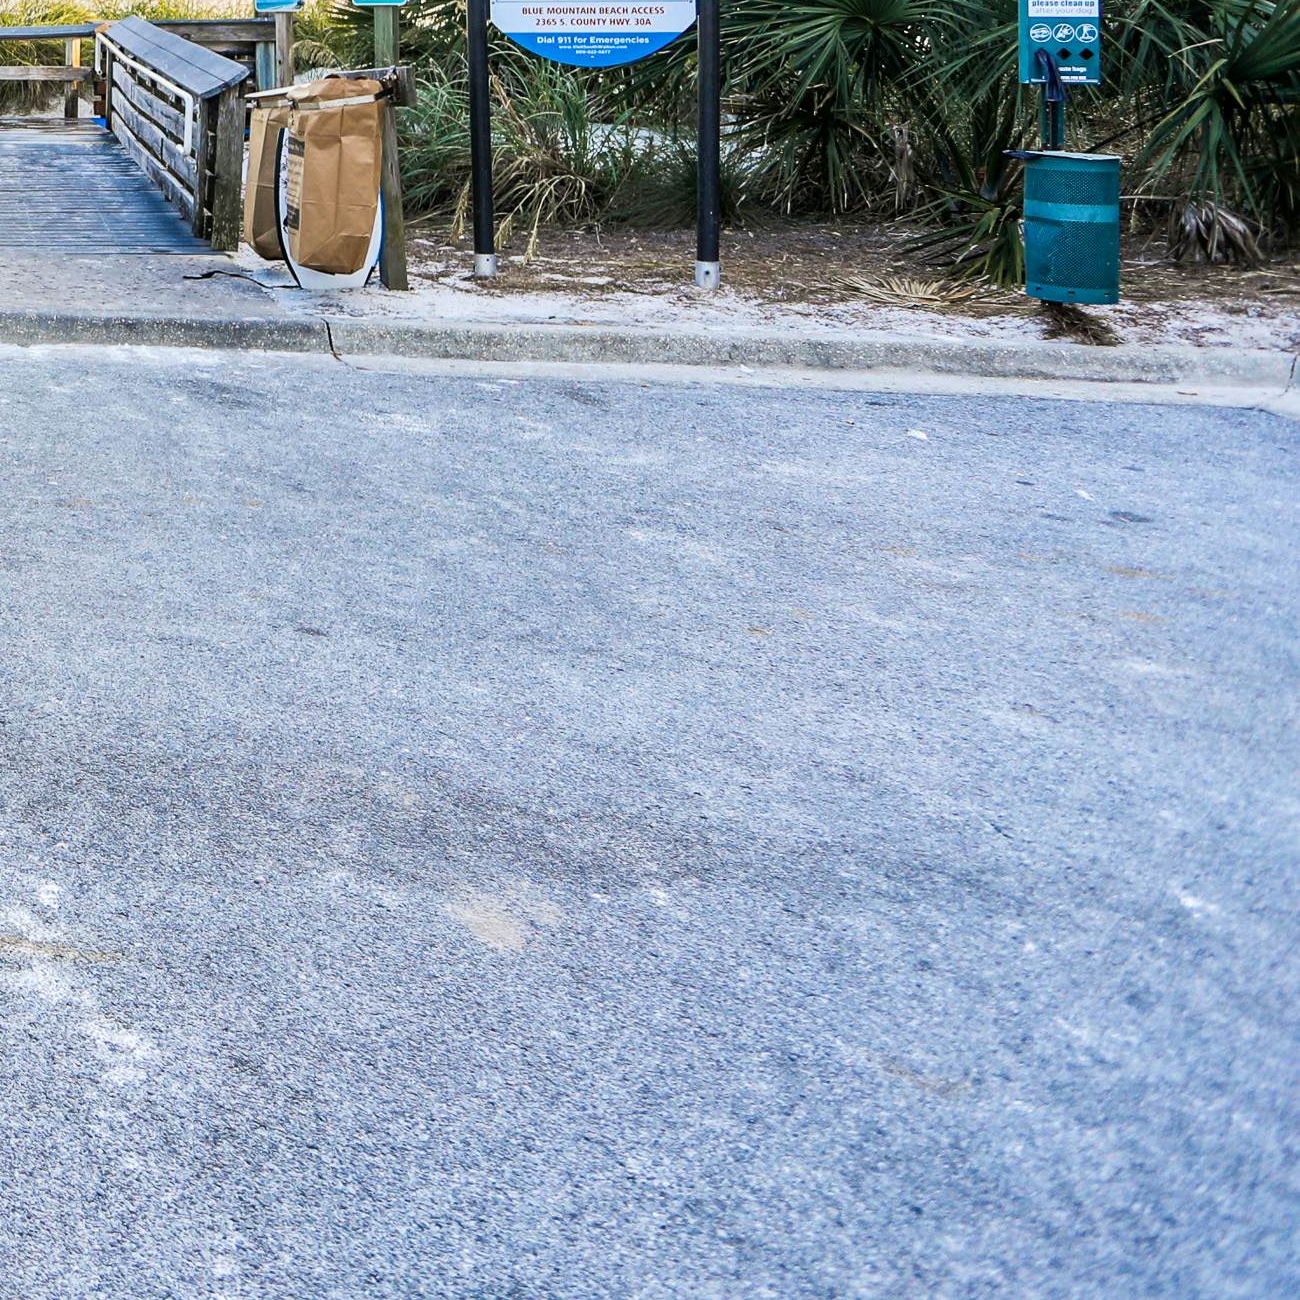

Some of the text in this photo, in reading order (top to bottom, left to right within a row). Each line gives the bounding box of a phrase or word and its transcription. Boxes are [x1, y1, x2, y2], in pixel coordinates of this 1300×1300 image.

[522, 6, 665, 15] BLUE MOUNTAIN BEACH ACCESS
[535, 18, 557, 26] 2365
[570, 18, 606, 26] COUNTY
[634, 17, 652, 26] 30A
[536, 36, 650, 45] Dial 911 for Emergencies
